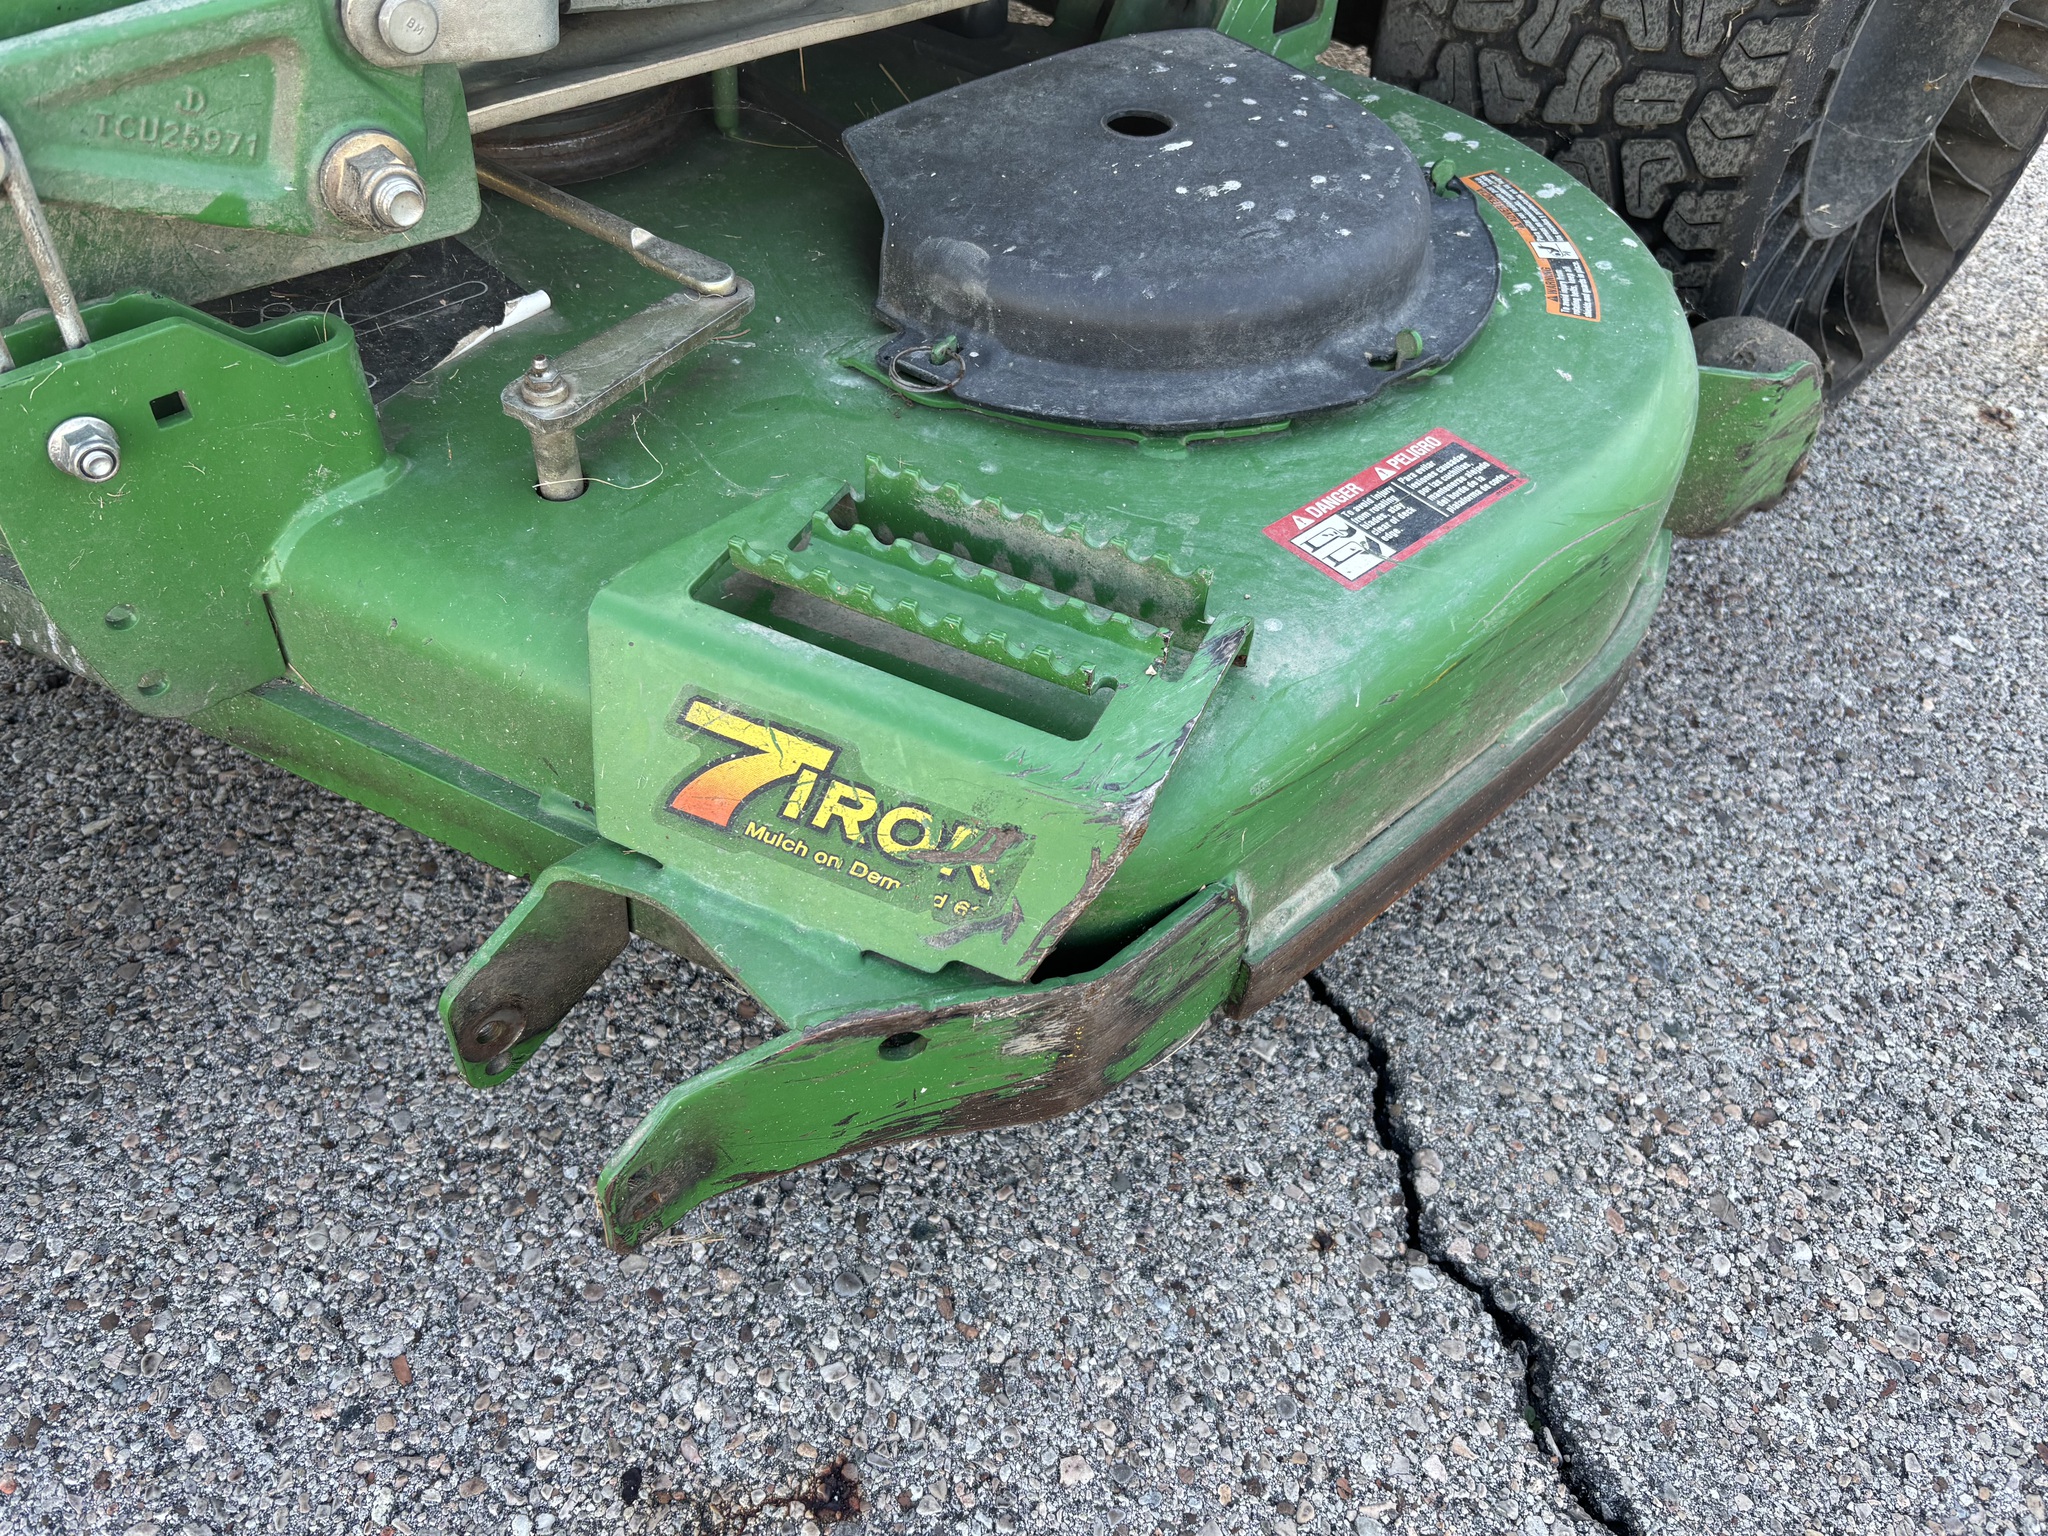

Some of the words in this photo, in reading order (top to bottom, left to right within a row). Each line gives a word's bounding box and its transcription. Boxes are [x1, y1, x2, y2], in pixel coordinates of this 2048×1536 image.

[405, 17, 425, 35] BM
[95, 110, 258, 158] TCU25971
[1541, 266, 1557, 294] WARNING
[1386, 436, 1442, 470] PELIGRO
[1397, 472, 1418, 485] Para
[1415, 461, 1436, 475] evitar
[1407, 470, 1438, 490] lesiones
[1436, 453, 1468, 473] causadas
[1417, 486, 1432, 497] por
[1428, 479, 1443, 488] las
[1440, 462, 1475, 481] cuchillas,
[1427, 476, 1468, 502] mantenerse
[1464, 461, 1491, 478] alejado
[1304, 482, 1365, 518] DANGER
[1341, 510, 1355, 518] To
[1352, 497, 1375, 512] avoid
[1370, 485, 1396, 501] injury
[1436, 497, 1451, 507] del
[1446, 485, 1470, 500] borde
[1466, 479, 1479, 489] de
[1474, 475, 1487, 483] la
[1446, 489, 1483, 514] plataforma
[1480, 483, 1492, 492] de
[1489, 474, 1510, 487] corte.
[1350, 511, 1372, 524] from
[1369, 495, 1400, 514] rotating
[1360, 513, 1391, 530] blades,
[1387, 502, 1406, 514] stay
[1371, 521, 1392, 536] clear
[1389, 516, 1400, 525] of
[1397, 506, 1417, 520] deck
[1381, 528, 1404, 542] edge.
[743, 821, 810, 860] Mulch
[813, 850, 842, 871] on
[848, 859, 949, 909] Demd
